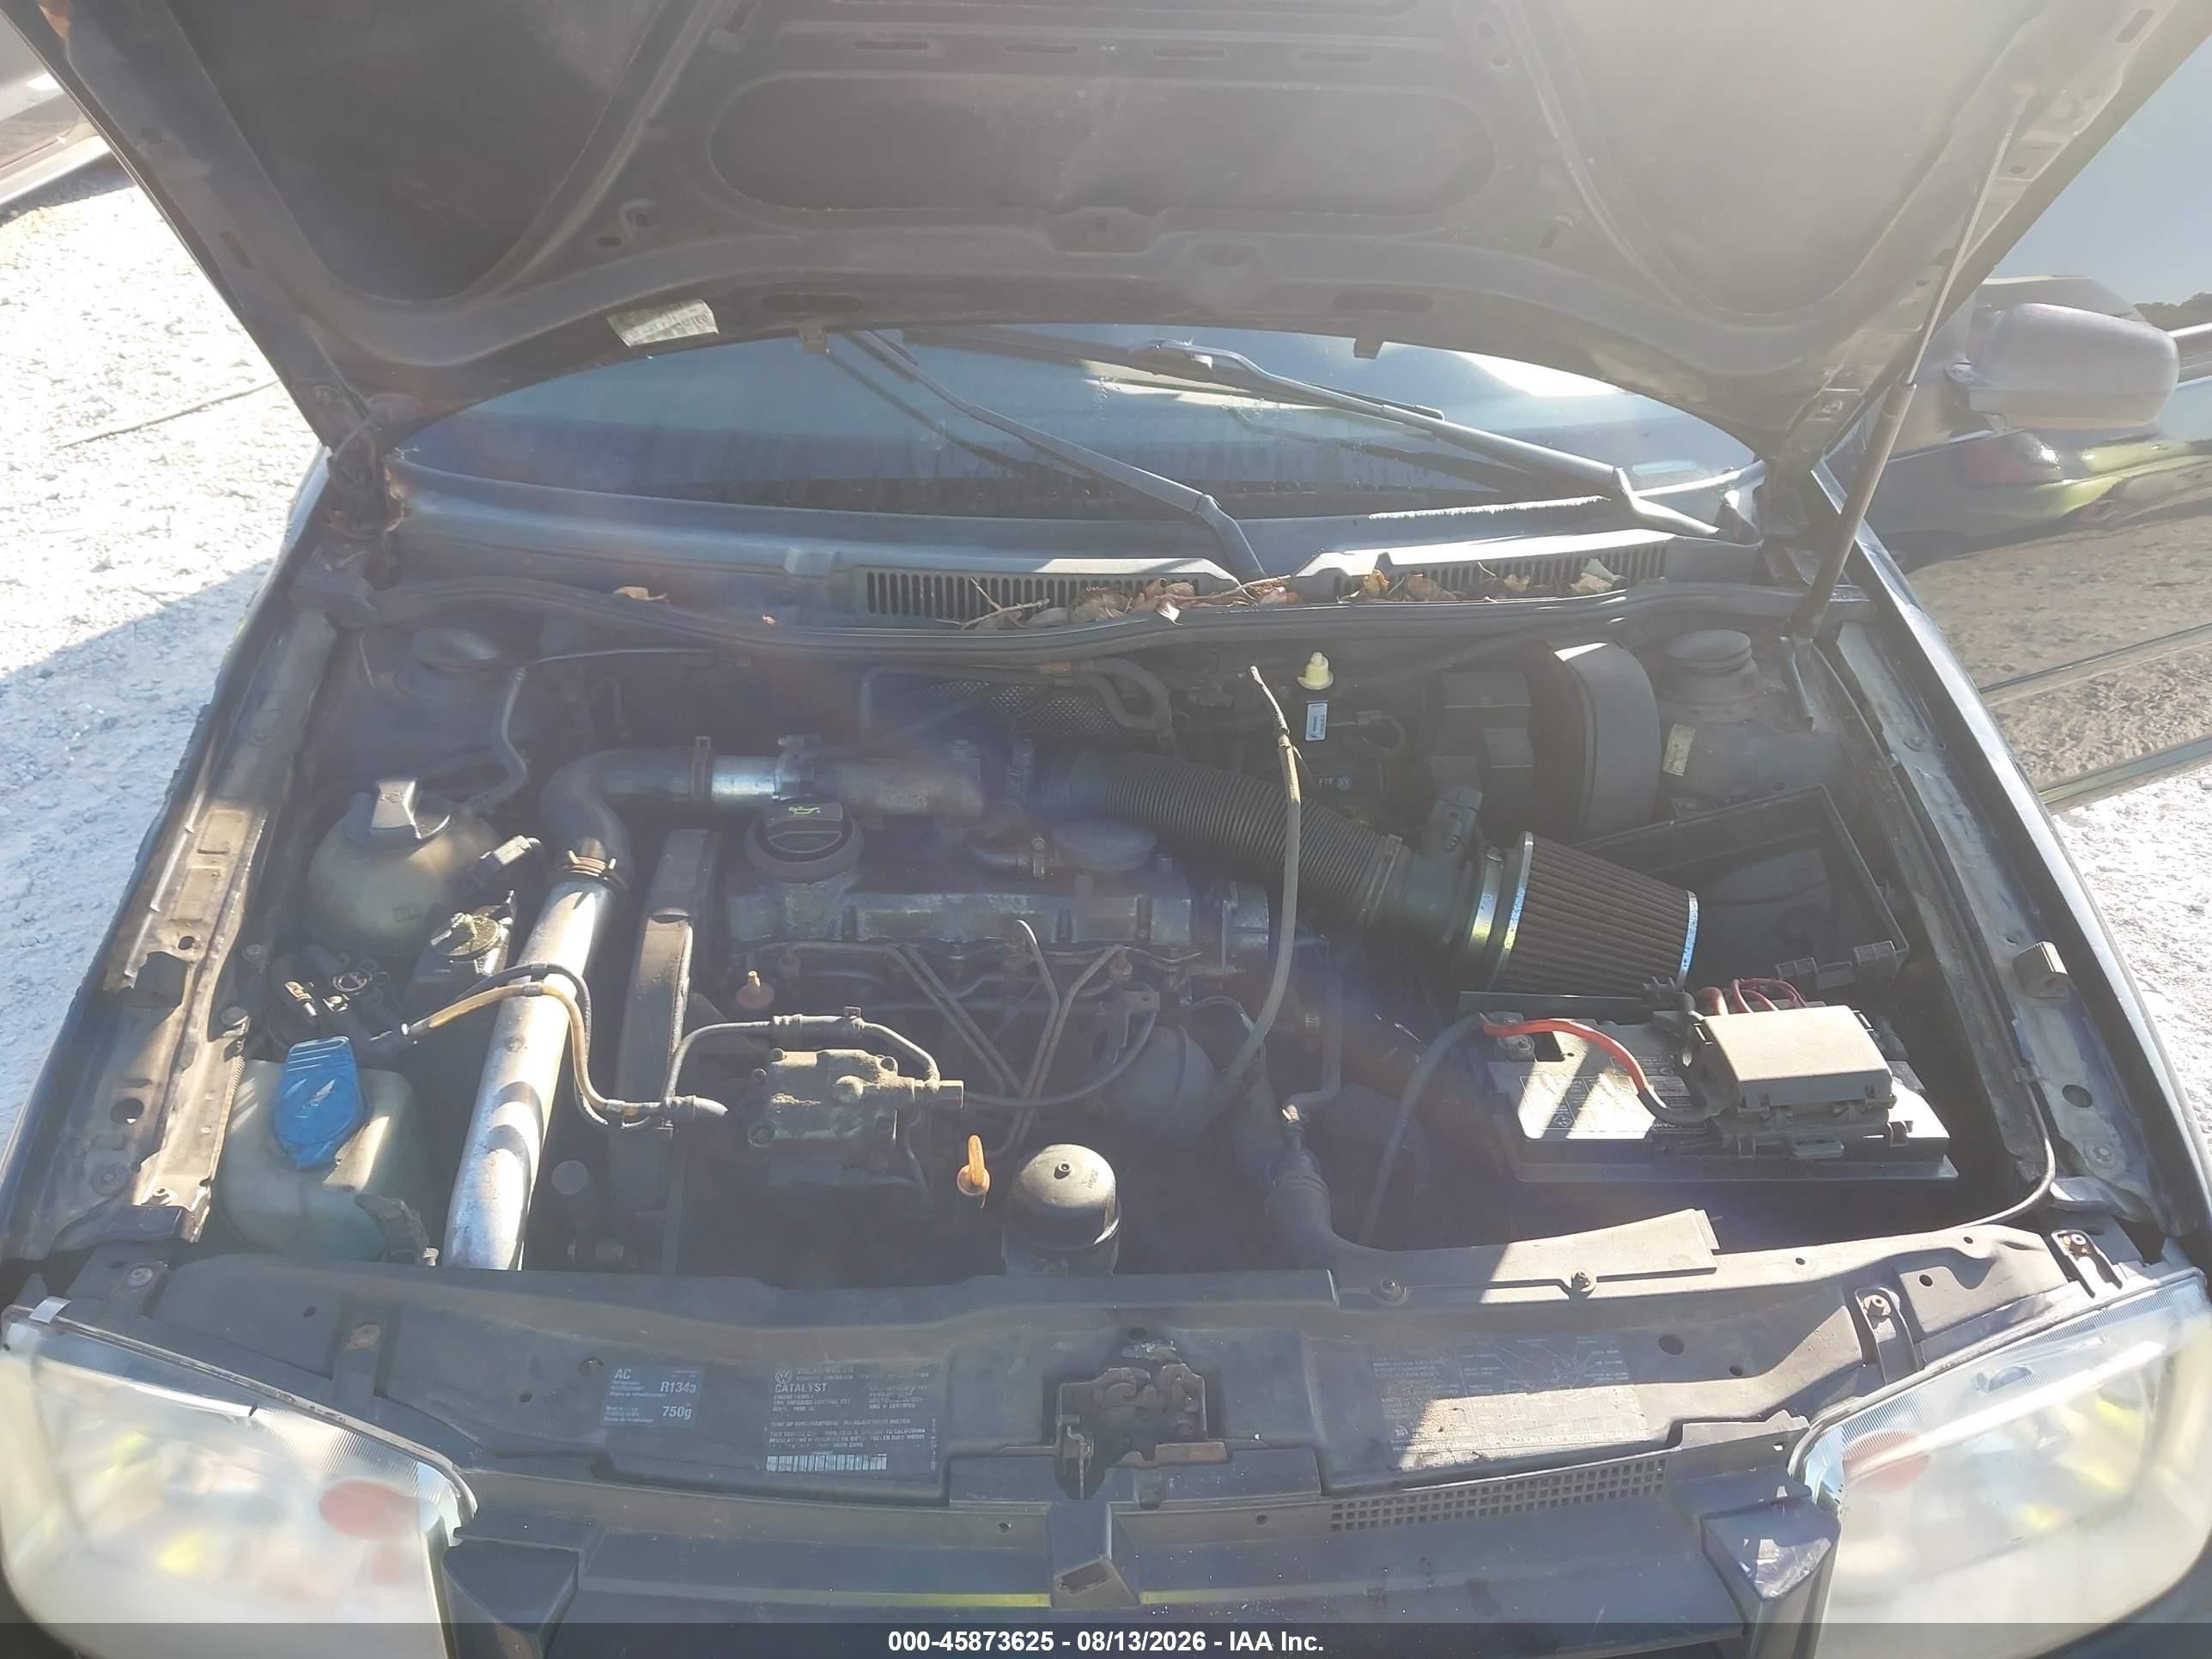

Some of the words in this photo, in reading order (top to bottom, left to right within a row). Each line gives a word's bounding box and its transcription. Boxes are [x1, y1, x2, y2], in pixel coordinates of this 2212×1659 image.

[613, 1367, 632, 1380] AC
[659, 1381, 697, 1394] R134a
[775, 1382, 829, 1393] CATALYST
[661, 1406, 693, 1420] 750g
